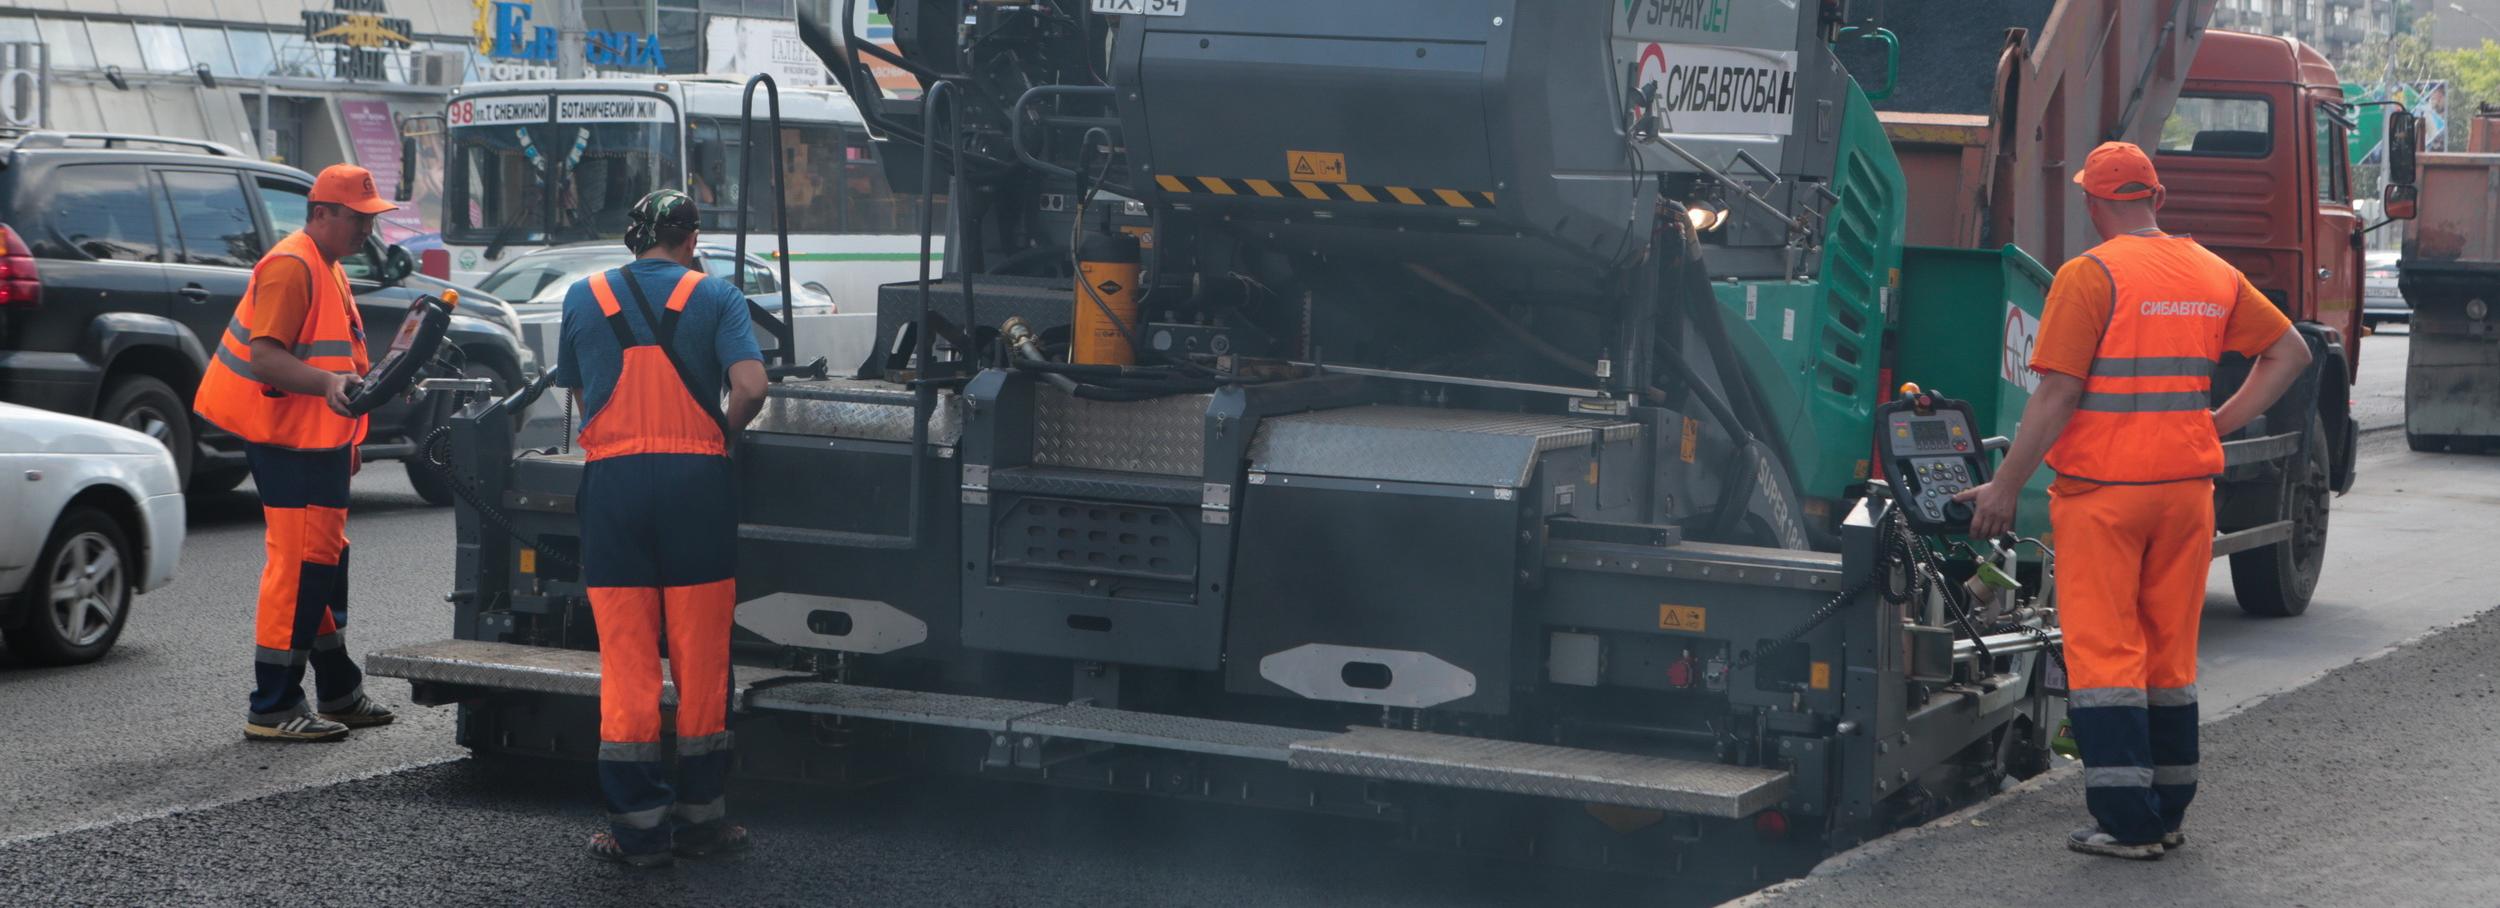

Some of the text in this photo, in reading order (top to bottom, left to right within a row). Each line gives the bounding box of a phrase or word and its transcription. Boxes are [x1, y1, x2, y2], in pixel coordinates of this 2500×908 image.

[492, 1, 667, 69] ЕВОПА
[451, 101, 473, 124] 98
[494, 98, 547, 120] СНЕЖИНОЙ
[561, 97, 635, 119] БОТАНИЧЕСКИЙ
[1667, 65, 1796, 115] СИБАВТОБАН
[1758, 456, 1788, 534] SUPER
